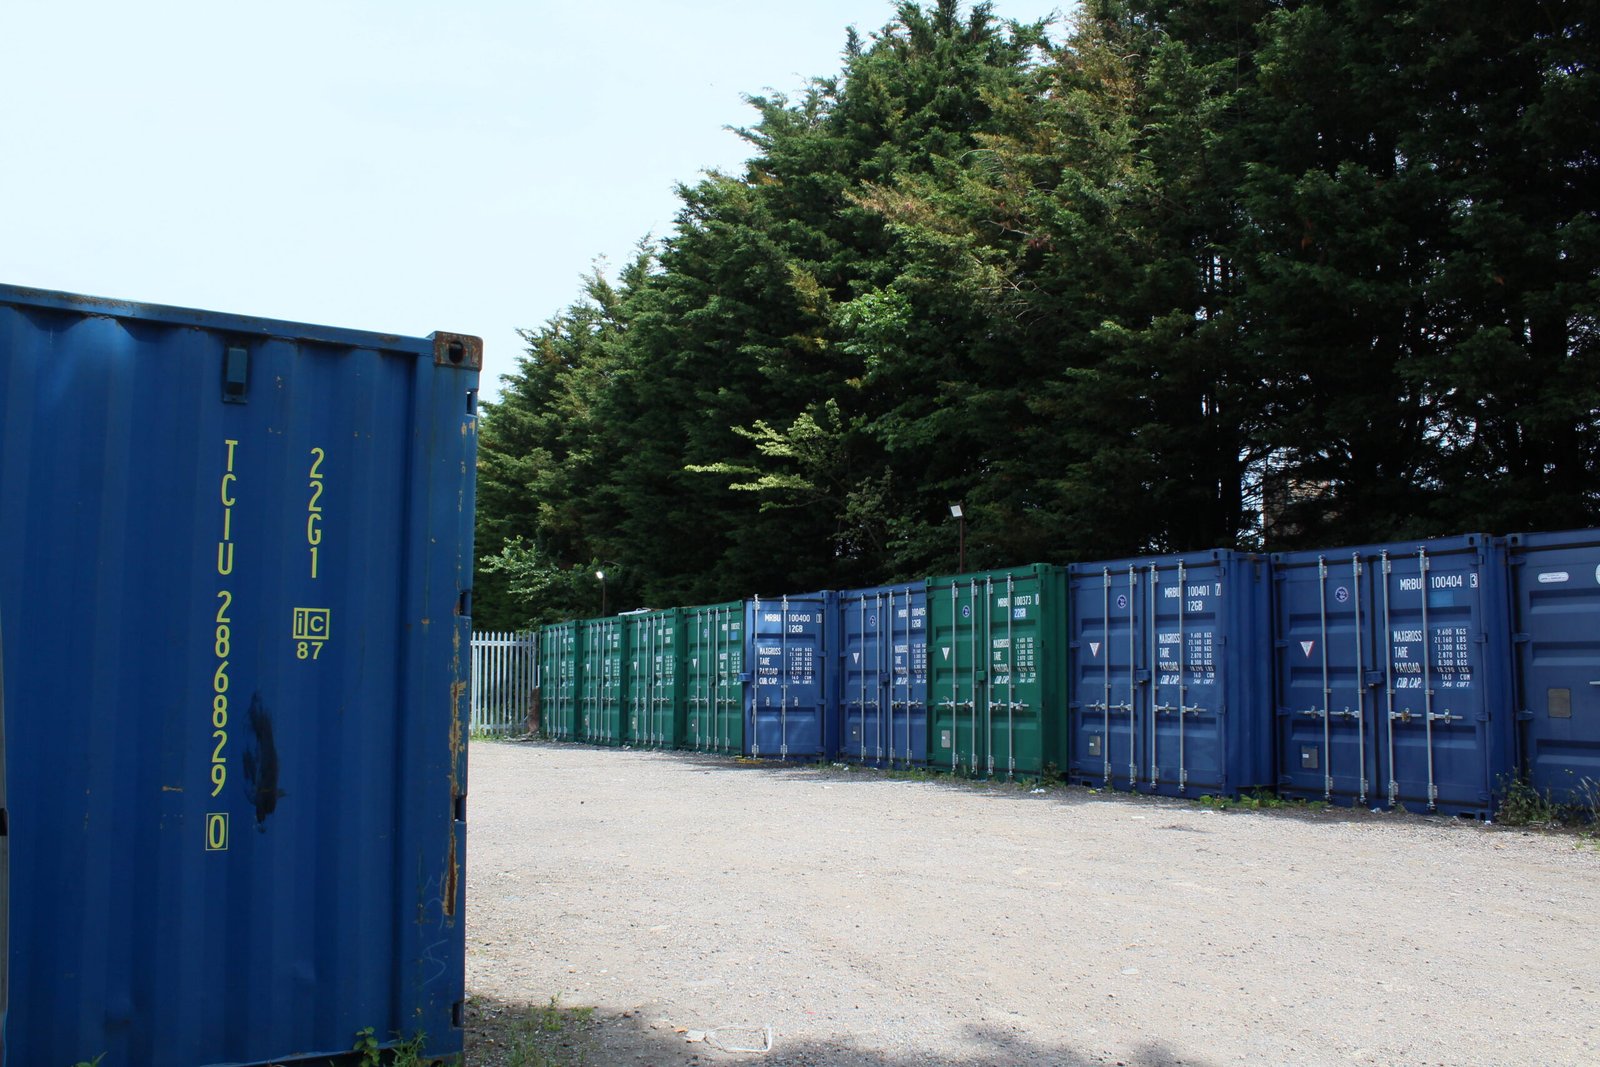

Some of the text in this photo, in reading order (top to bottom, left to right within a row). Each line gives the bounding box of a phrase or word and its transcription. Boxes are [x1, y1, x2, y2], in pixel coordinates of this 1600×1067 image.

[307, 447, 324, 578] 22G1
[1400, 574, 1477, 590] MRBU 100404 3
[1187, 585, 1209, 596] 100401
[1188, 601, 1202, 612] 12GB
[1394, 630, 1422, 642] MAXGROSS
[207, 439, 238, 849] TCIU 286829 0
[296, 642, 324, 659] 87
[1394, 647, 1408, 658] TARE
[1395, 662, 1421, 673] PAYLOAD
